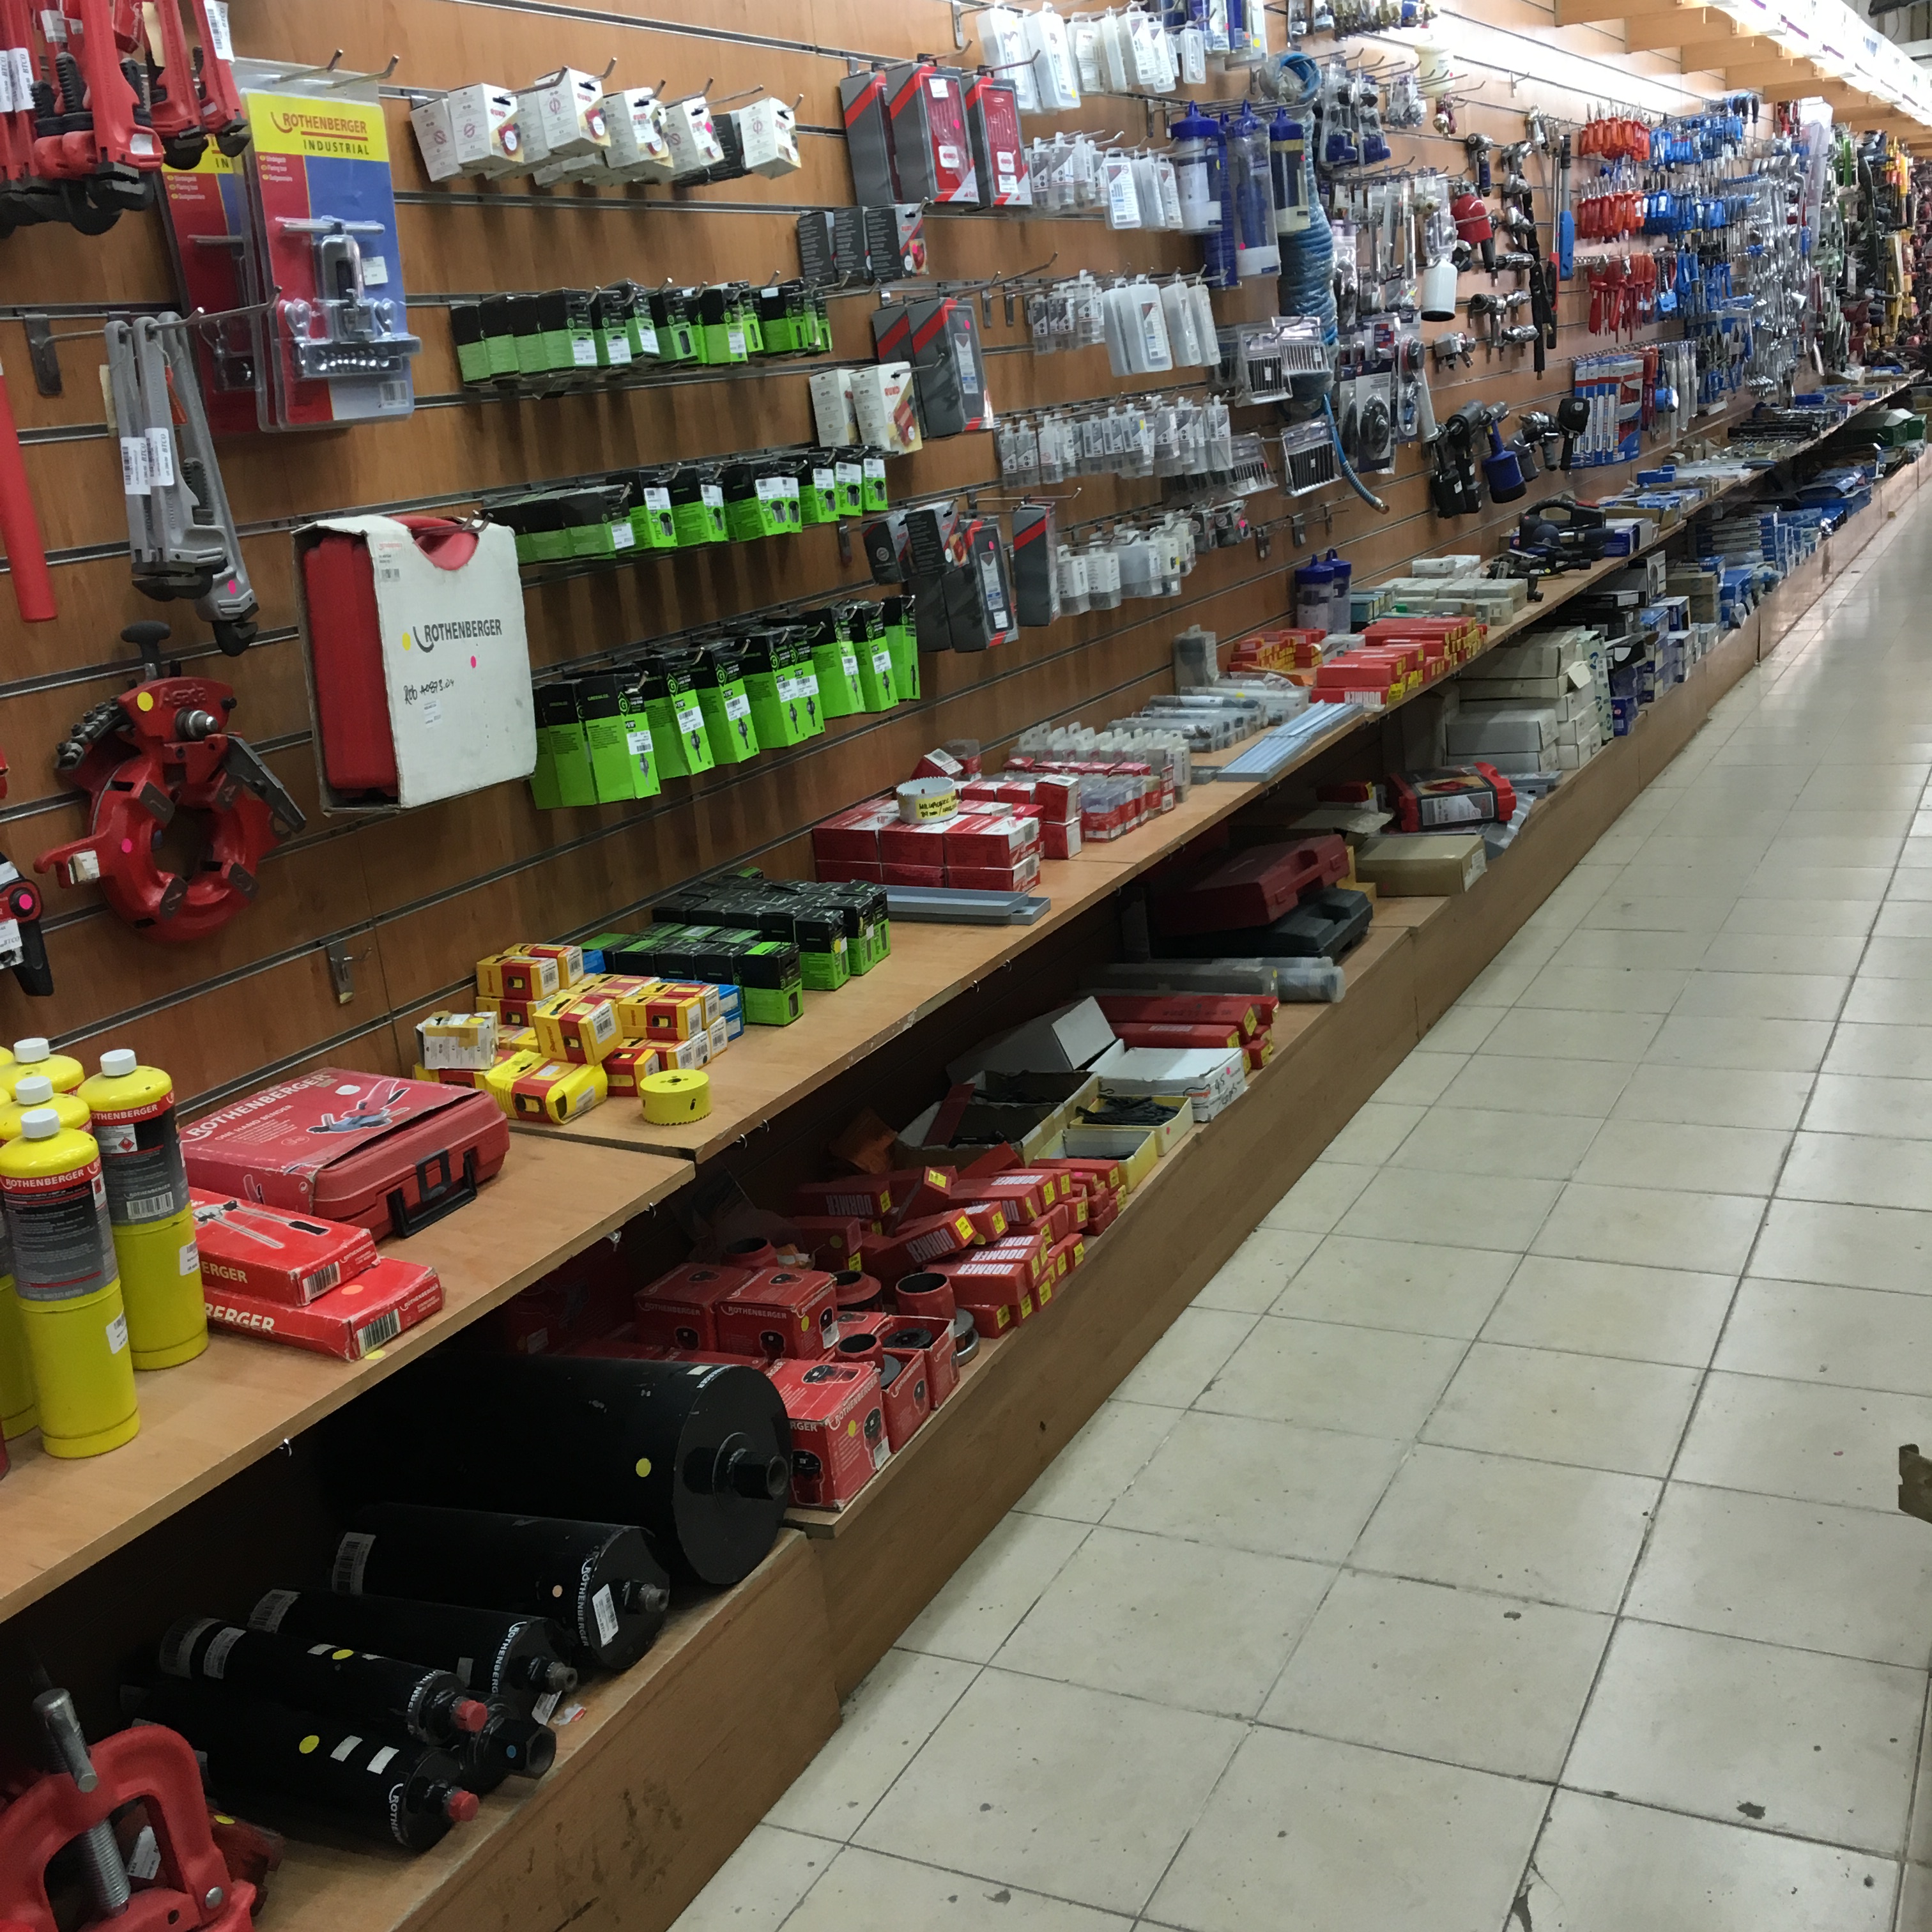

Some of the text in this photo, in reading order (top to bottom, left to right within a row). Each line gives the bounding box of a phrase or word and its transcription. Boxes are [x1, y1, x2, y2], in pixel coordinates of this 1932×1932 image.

[19, 53, 31, 75] BTCO
[490, 108, 506, 118] RUKO
[282, 113, 368, 134] ROTHENBERGER
[303, 139, 370, 155] INDUSTRIAL
[424, 618, 502, 643] ROTHENBERGER
[716, 668, 725, 682] G
[669, 677, 677, 693] G
[618, 698, 627, 712] G
[185, 1073, 332, 1137] ROTHENBERGER
[214, 1130, 234, 1141] ONE
[236, 1119, 261, 1132] HAND
[259, 1105, 295, 1121] BENDER
[4, 1169, 84, 1188] ROTHENBERGER
[128, 1183, 171, 1198] ROTHENBERGER
[825, 1194, 874, 1216] DORMER
[905, 1227, 956, 1263] DORMER
[970, 1248, 1028, 1262] DORMER
[956, 1264, 1015, 1275] DORMER
[643, 1301, 701, 1316] ROTHENBERGER
[728, 1306, 787, 1320] ROTHENBERGER
[834, 1376, 879, 1424] ROTHENBERGER
[790, 1420, 818, 1432] RGER
[577, 1565, 592, 1647] ROTHENBERGER
[491, 1626, 521, 1694] ROTHENBERG
